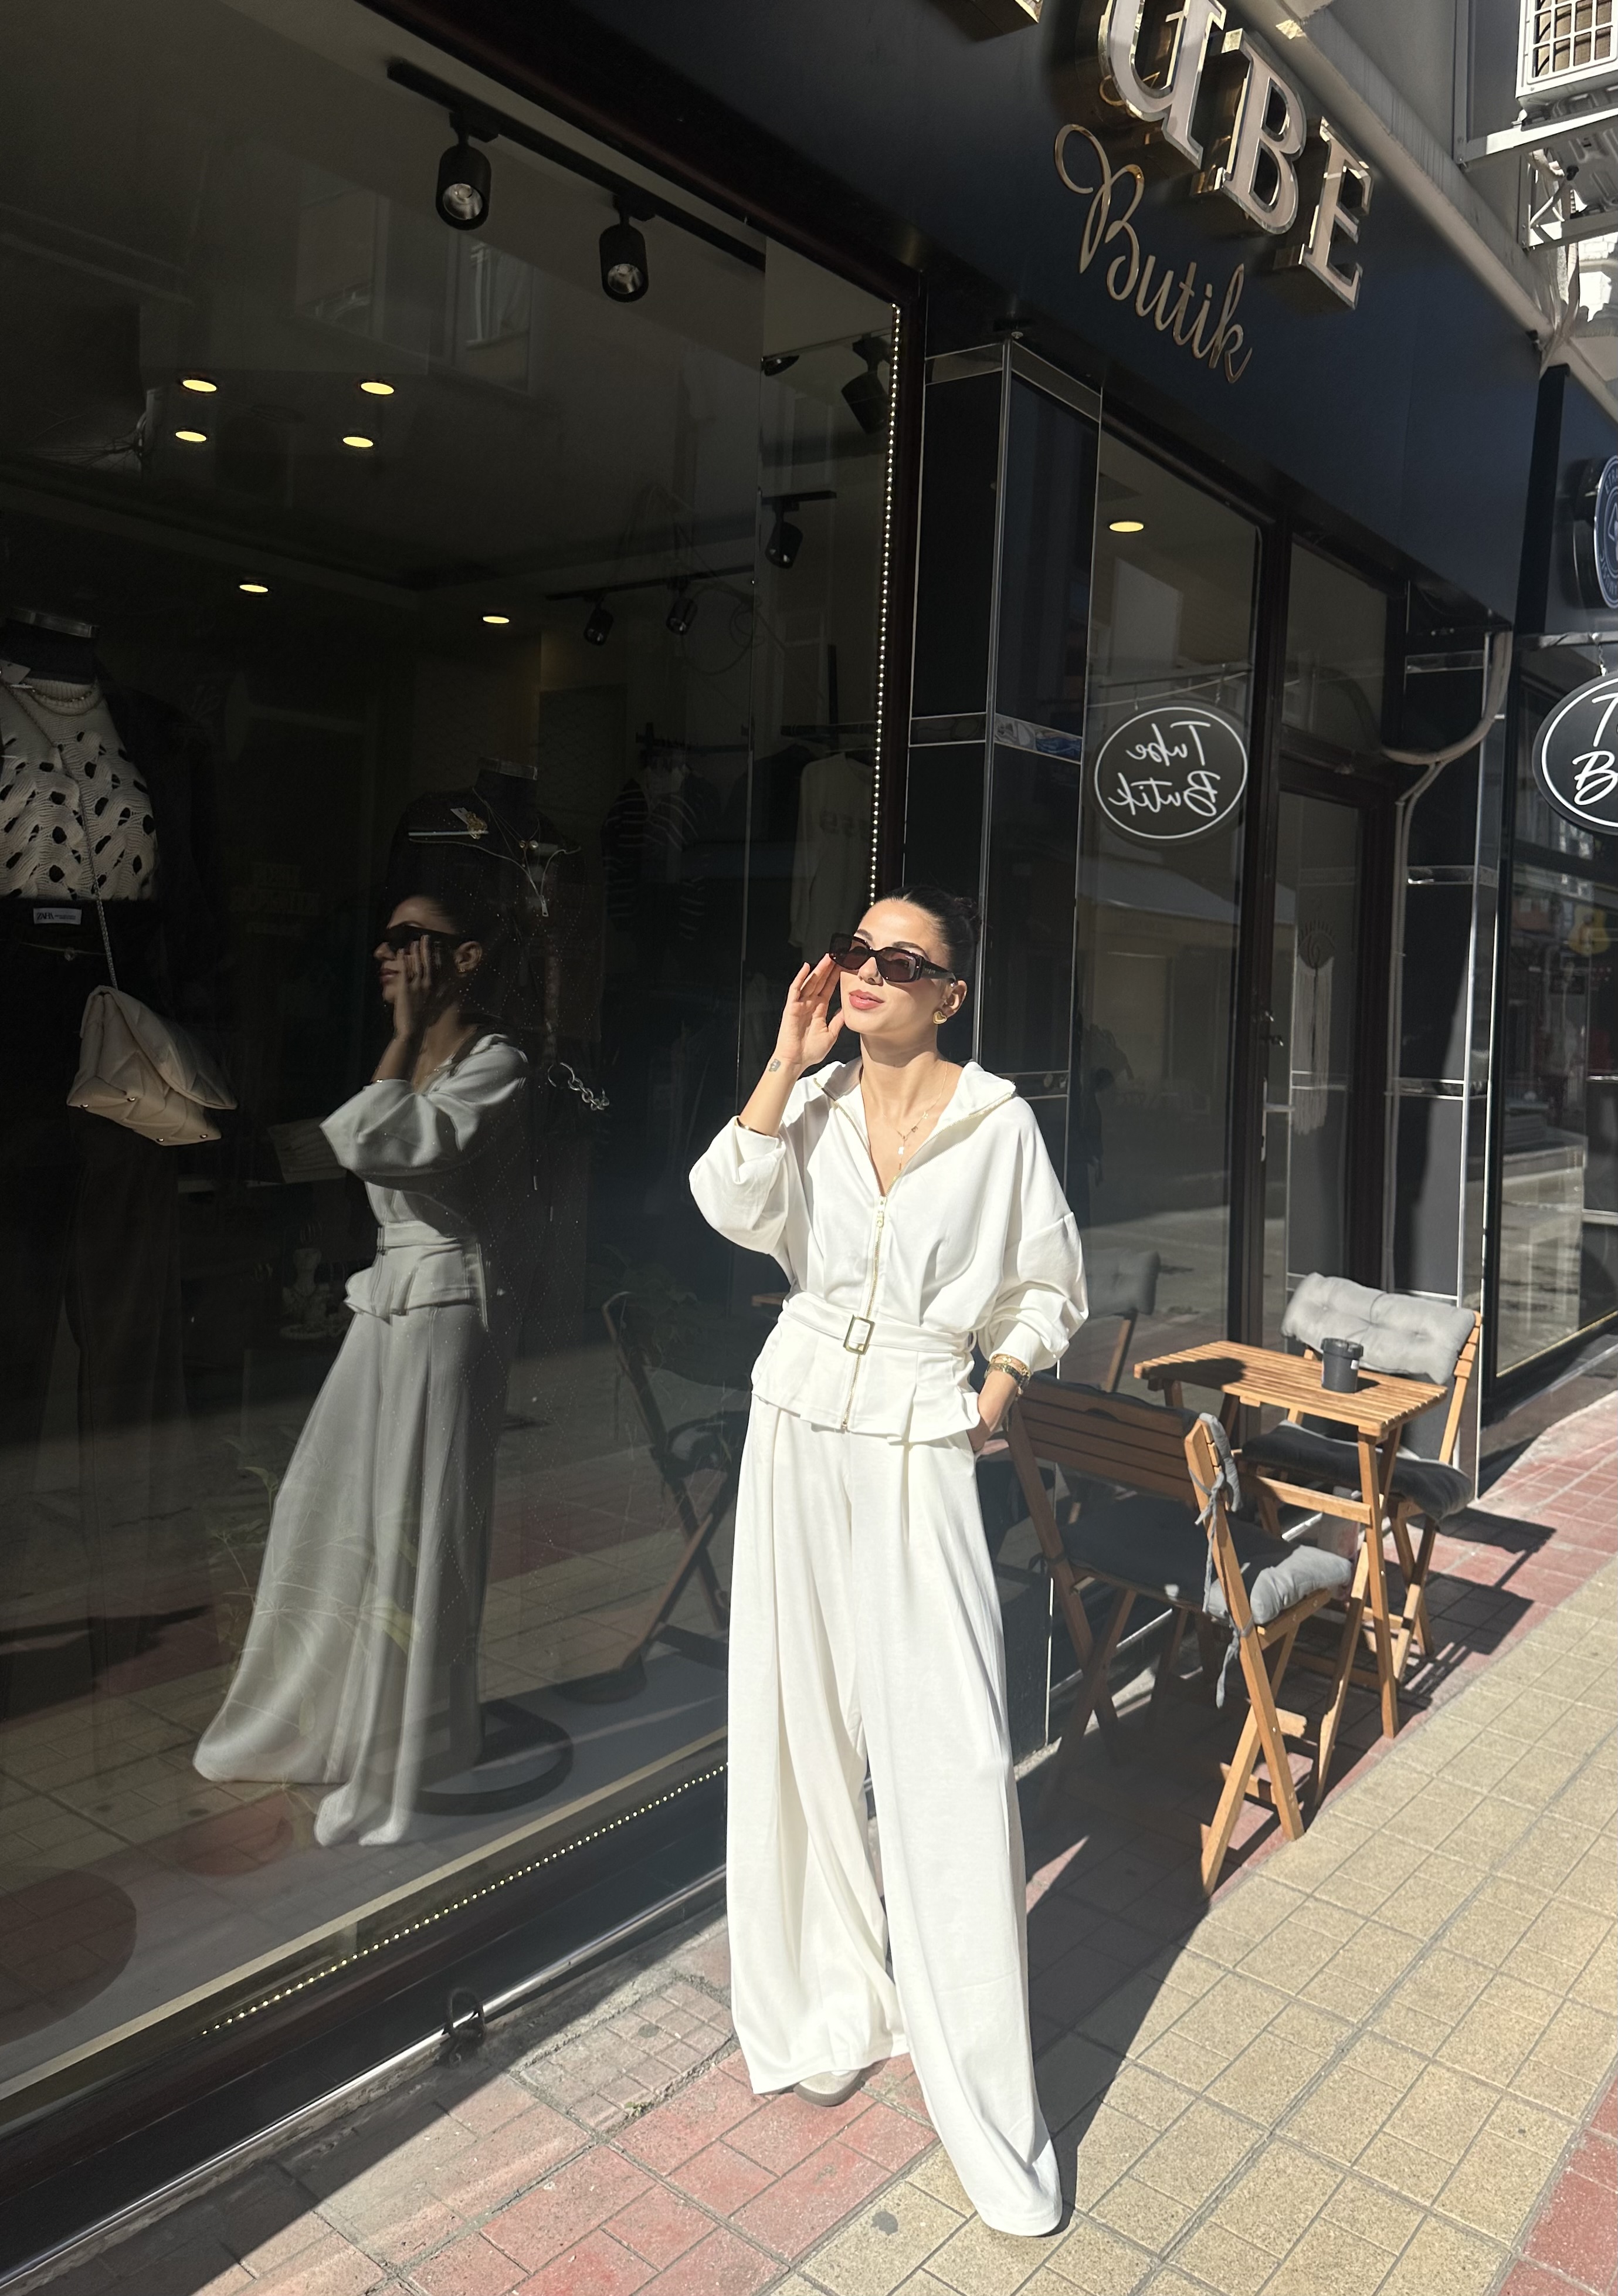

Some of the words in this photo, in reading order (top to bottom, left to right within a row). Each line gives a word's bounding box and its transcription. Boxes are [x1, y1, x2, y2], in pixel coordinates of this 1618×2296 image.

[1015, 0, 1373, 310] UBE
[1054, 123, 1253, 384] Butik
[1572, 750, 1618, 806] B
[1591, 692, 1618, 747] T
